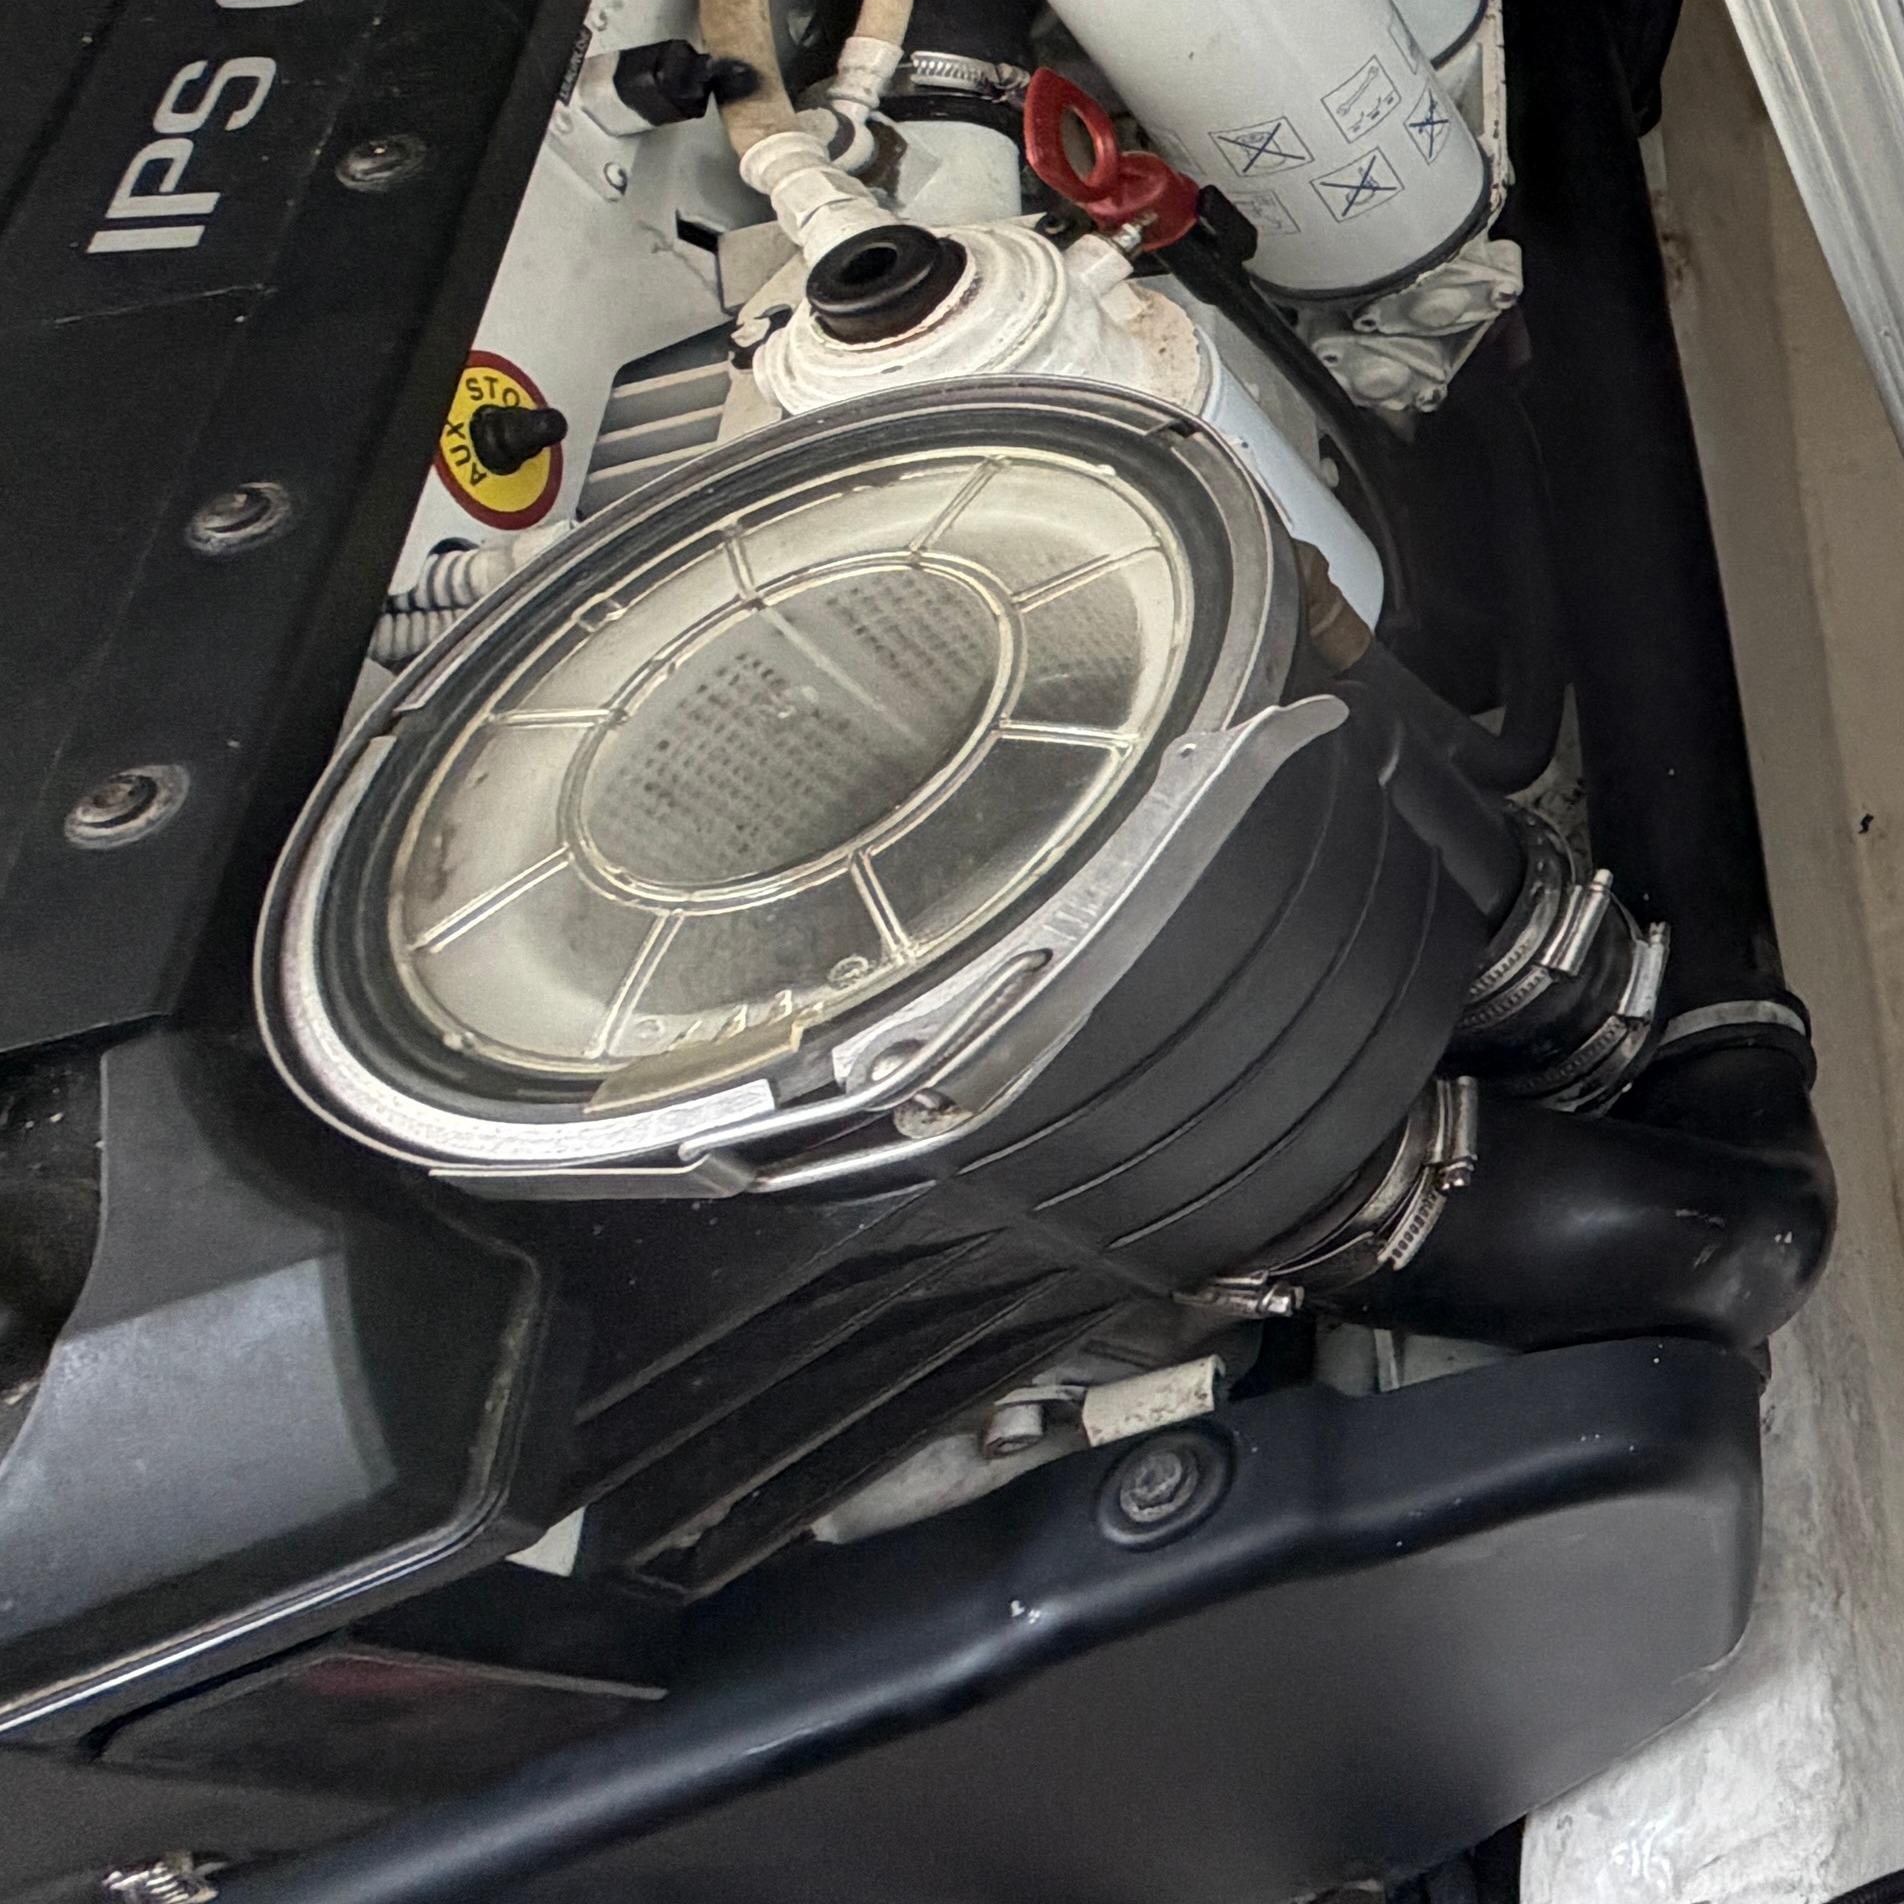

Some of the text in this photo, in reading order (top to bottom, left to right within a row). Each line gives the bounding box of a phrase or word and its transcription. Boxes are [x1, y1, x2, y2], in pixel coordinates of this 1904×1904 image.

[87, 56, 276, 253] IPS
[446, 375, 520, 486] AUX STO
